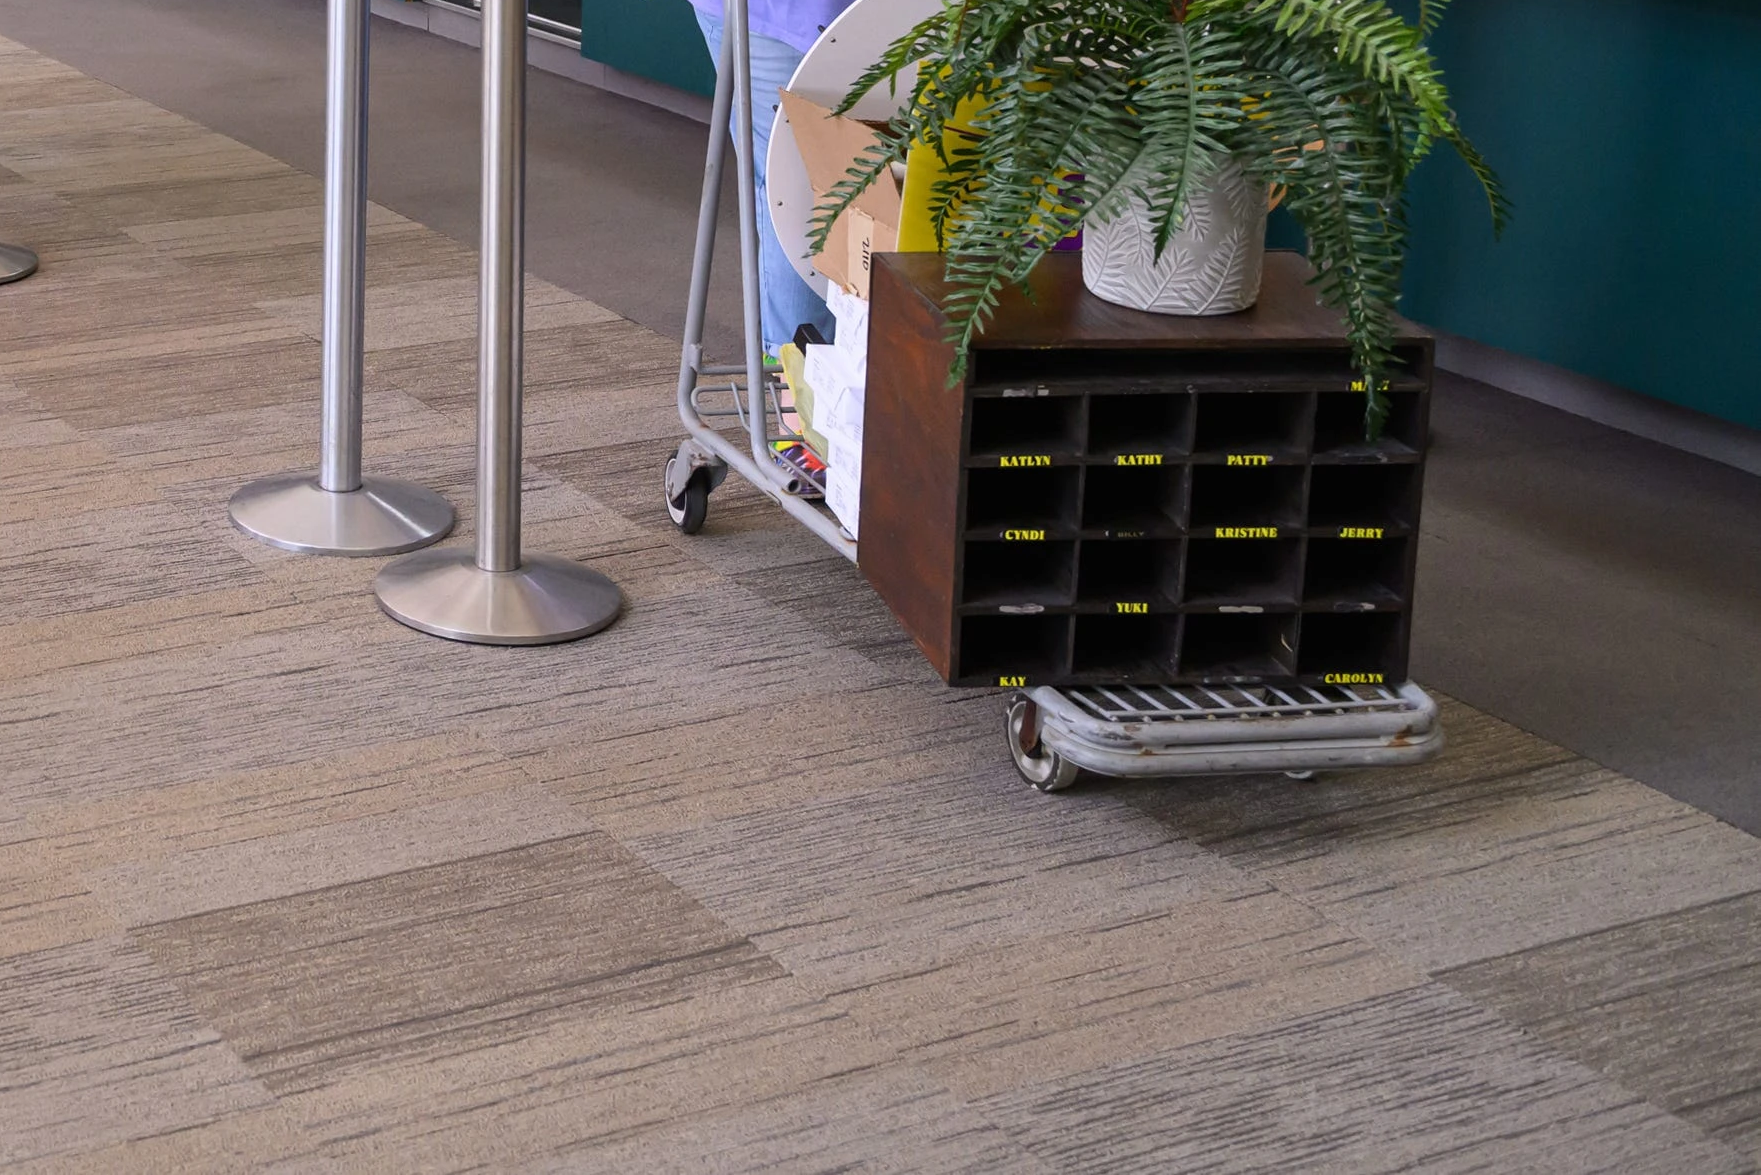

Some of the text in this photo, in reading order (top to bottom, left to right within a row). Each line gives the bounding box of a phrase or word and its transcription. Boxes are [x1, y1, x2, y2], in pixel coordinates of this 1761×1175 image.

[1000, 455, 1051, 467] KATLYN
[1117, 454, 1163, 466] KATHY
[1227, 455, 1269, 466] PATTY
[1005, 530, 1045, 541] CYNDI
[1215, 527, 1277, 539] KRISTINE
[1339, 527, 1384, 539] JERRY
[1116, 602, 1149, 614] YUKI
[999, 676, 1026, 687] KAY
[1324, 673, 1384, 684] CAROLYN
